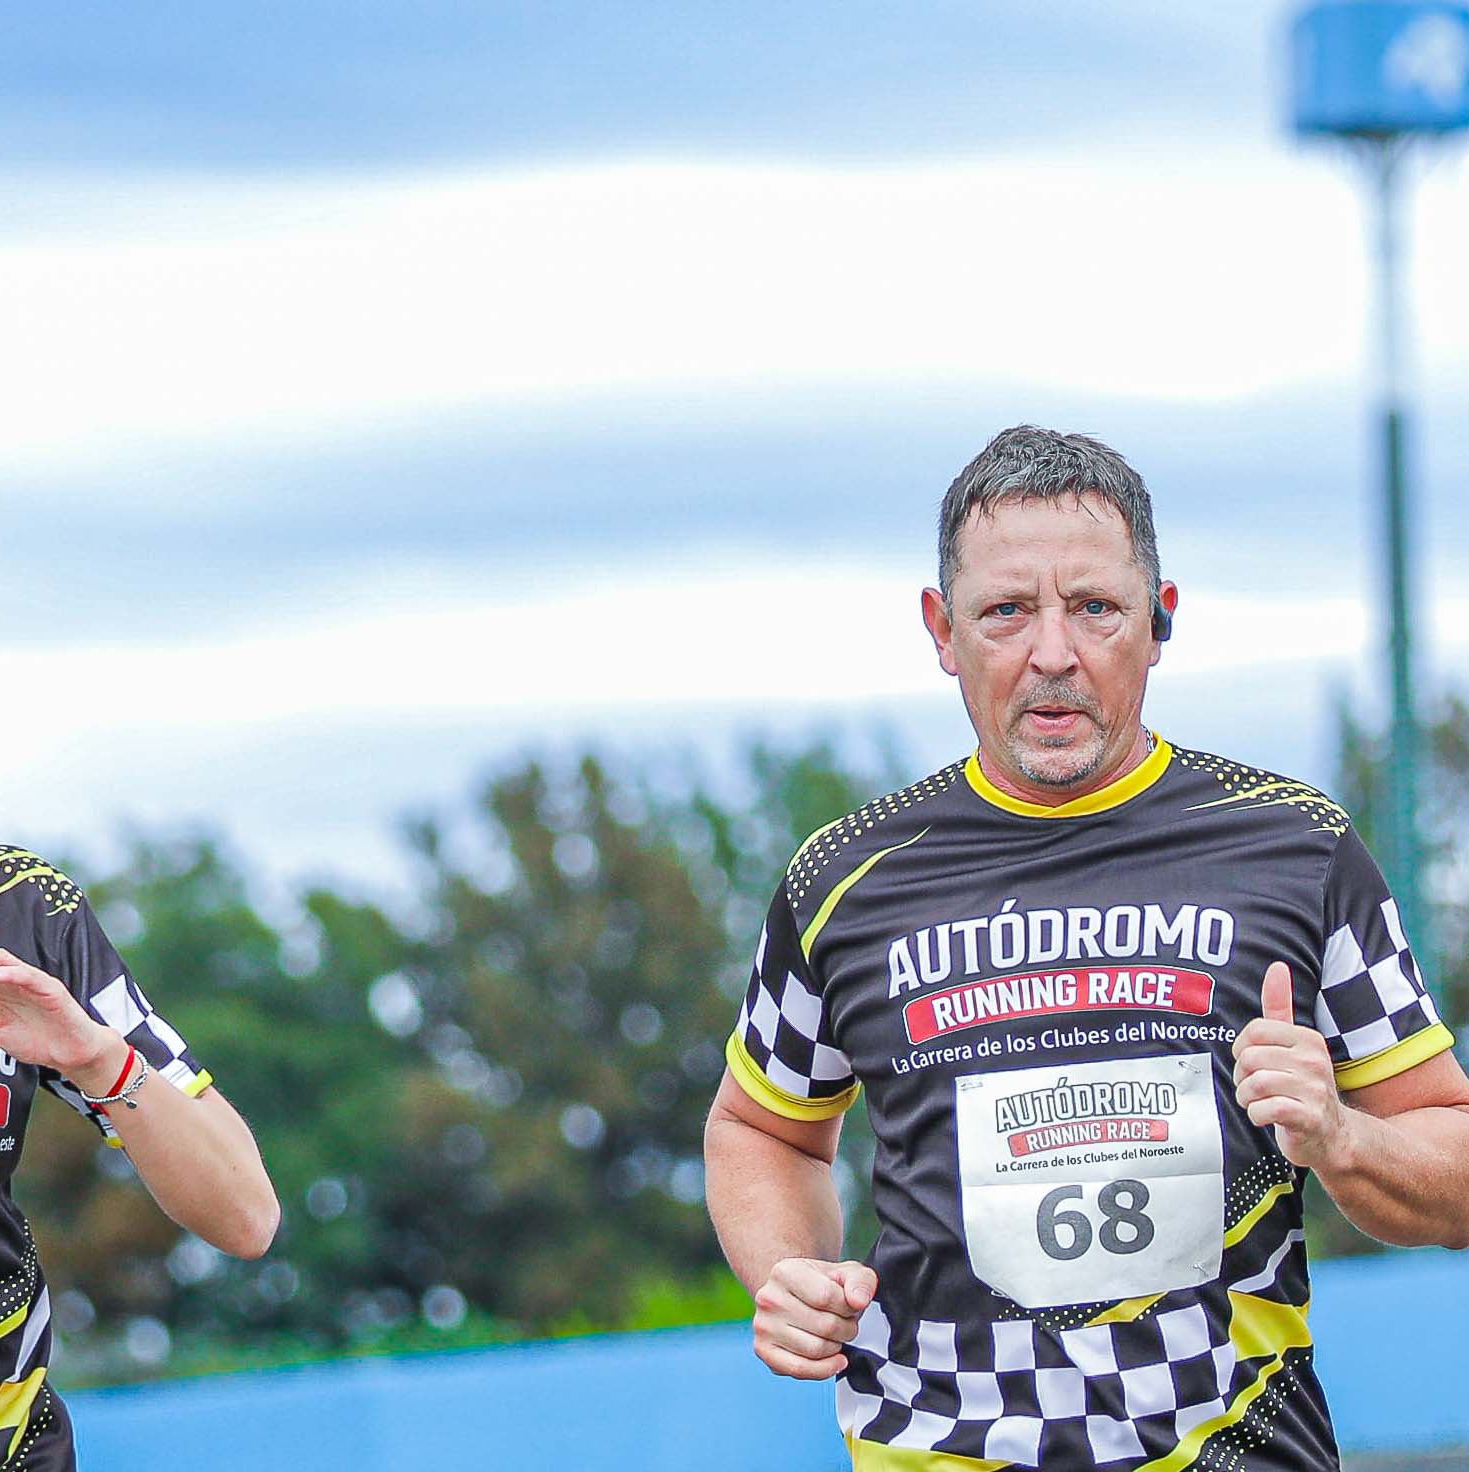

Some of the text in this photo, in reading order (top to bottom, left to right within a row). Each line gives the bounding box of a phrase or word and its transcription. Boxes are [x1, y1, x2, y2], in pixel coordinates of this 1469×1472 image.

[887, 899, 1235, 998] AUTÓDROMO
[931, 971, 1177, 1031] RUNNING RACE
[891, 1021, 1236, 1075] La Carrera de los Clubes del Noroeste
[996, 1077, 1177, 1133] AUTÓDROMO
[995, 1145, 1184, 1173] La Carrera de los Clubes del Noroeste
[1025, 1121, 1151, 1151] RUNNING RACE
[1036, 1179, 1155, 1261] 68
